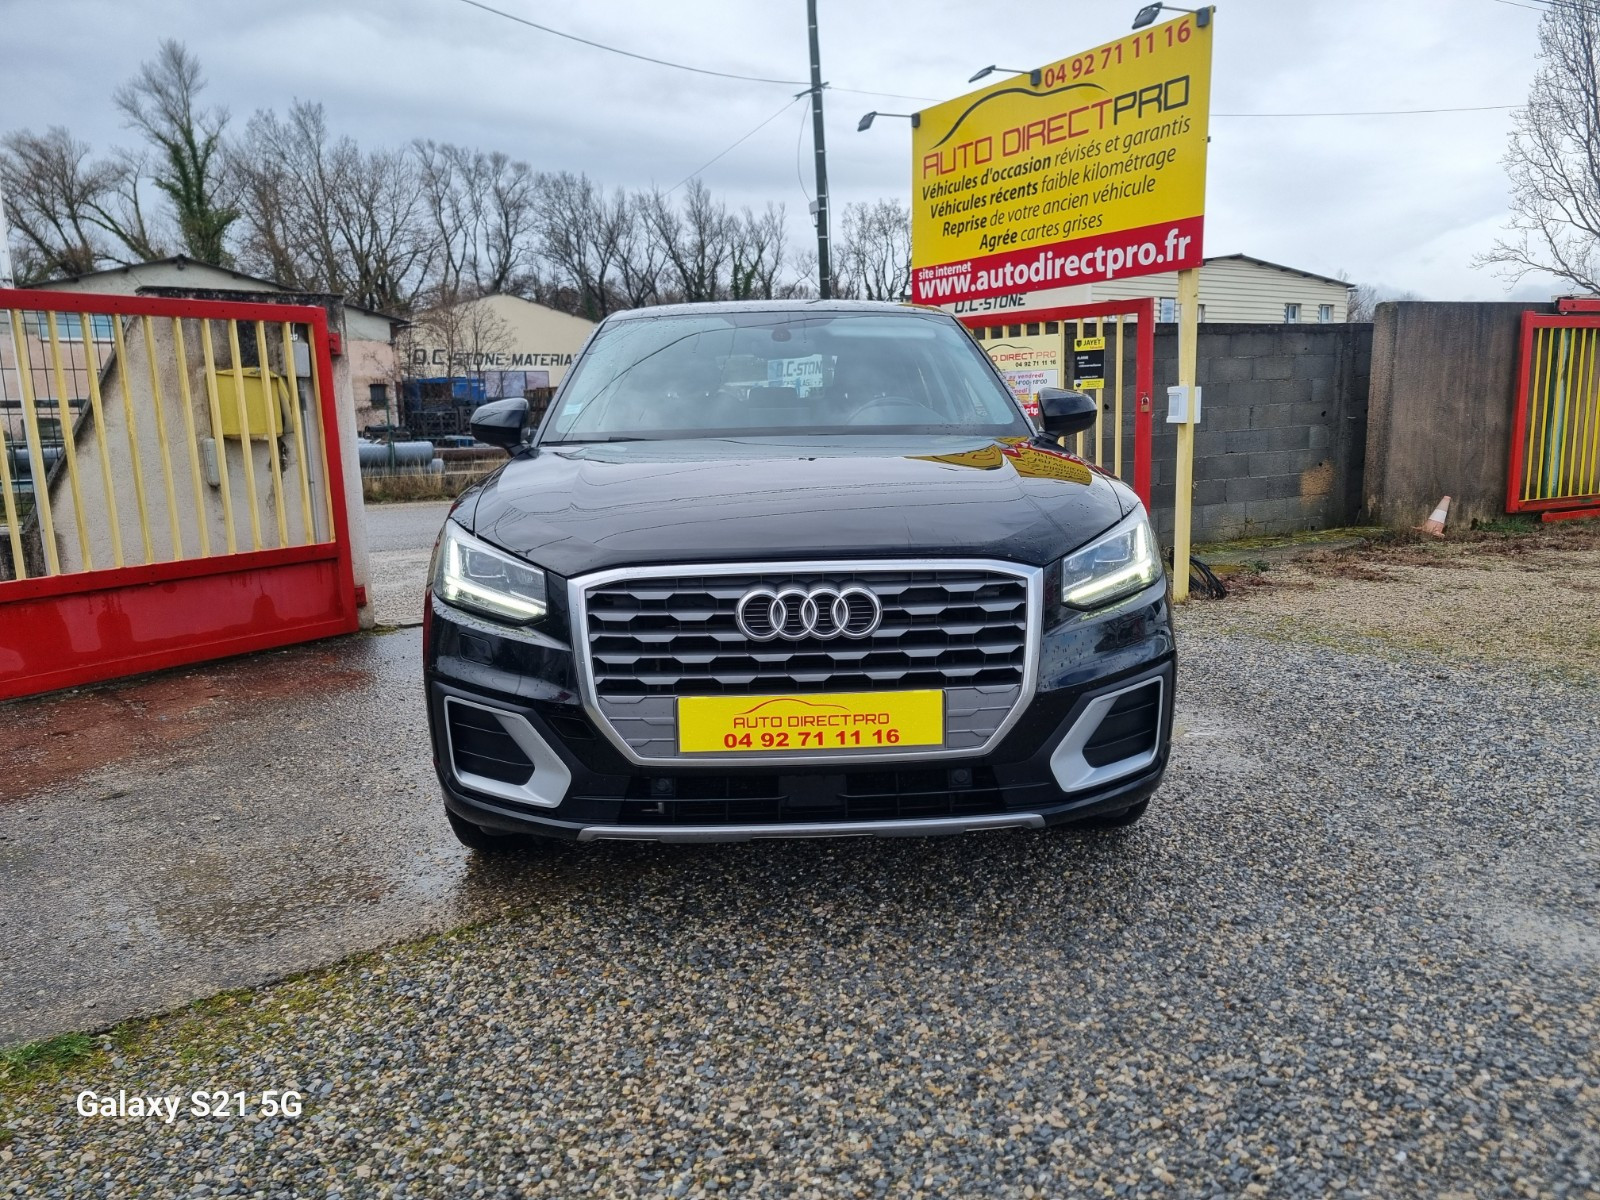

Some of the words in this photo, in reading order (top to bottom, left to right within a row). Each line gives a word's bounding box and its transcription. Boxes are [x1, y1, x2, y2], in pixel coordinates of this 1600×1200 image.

[1044, 63, 1067, 88] 04
[1071, 53, 1095, 80] 92
[1100, 43, 1123, 70] 71
[1132, 31, 1155, 59] 11
[1164, 18, 1192, 48] 16
[922, 174, 979, 201] Véhicules
[980, 155, 1052, 187] d'occasion
[1054, 138, 1102, 168] révisés
[1104, 134, 1121, 154] et
[1122, 114, 1192, 154] garantis
[923, 135, 993, 180] AUTO
[930, 193, 987, 219] Véhicules
[989, 181, 1039, 206] récents
[1040, 168, 1081, 193] faible
[1082, 147, 1178, 184] kilométrage
[941, 214, 988, 239] Reprise
[989, 208, 1006, 227] de
[1007, 202, 1041, 223] votre
[1042, 191, 1090, 216] ancien
[1092, 174, 1157, 206] véhicule
[978, 228, 1019, 253] Agrée
[1019, 219, 1061, 242] cartes
[1062, 212, 1104, 239] grises
[918, 227, 1192, 300] www.autodirectpro.fr
[918, 268, 935, 281] site
[935, 261, 973, 277] internet
[1000, 352, 1034, 361] DIRECT
[1035, 350, 1057, 359] PRO
[723, 732, 754, 749] 04
[760, 731, 791, 748] 92
[797, 730, 825, 747] 71
[834, 728, 862, 746] 11
[872, 727, 901, 745] 16
[733, 715, 783, 730] AUTO
